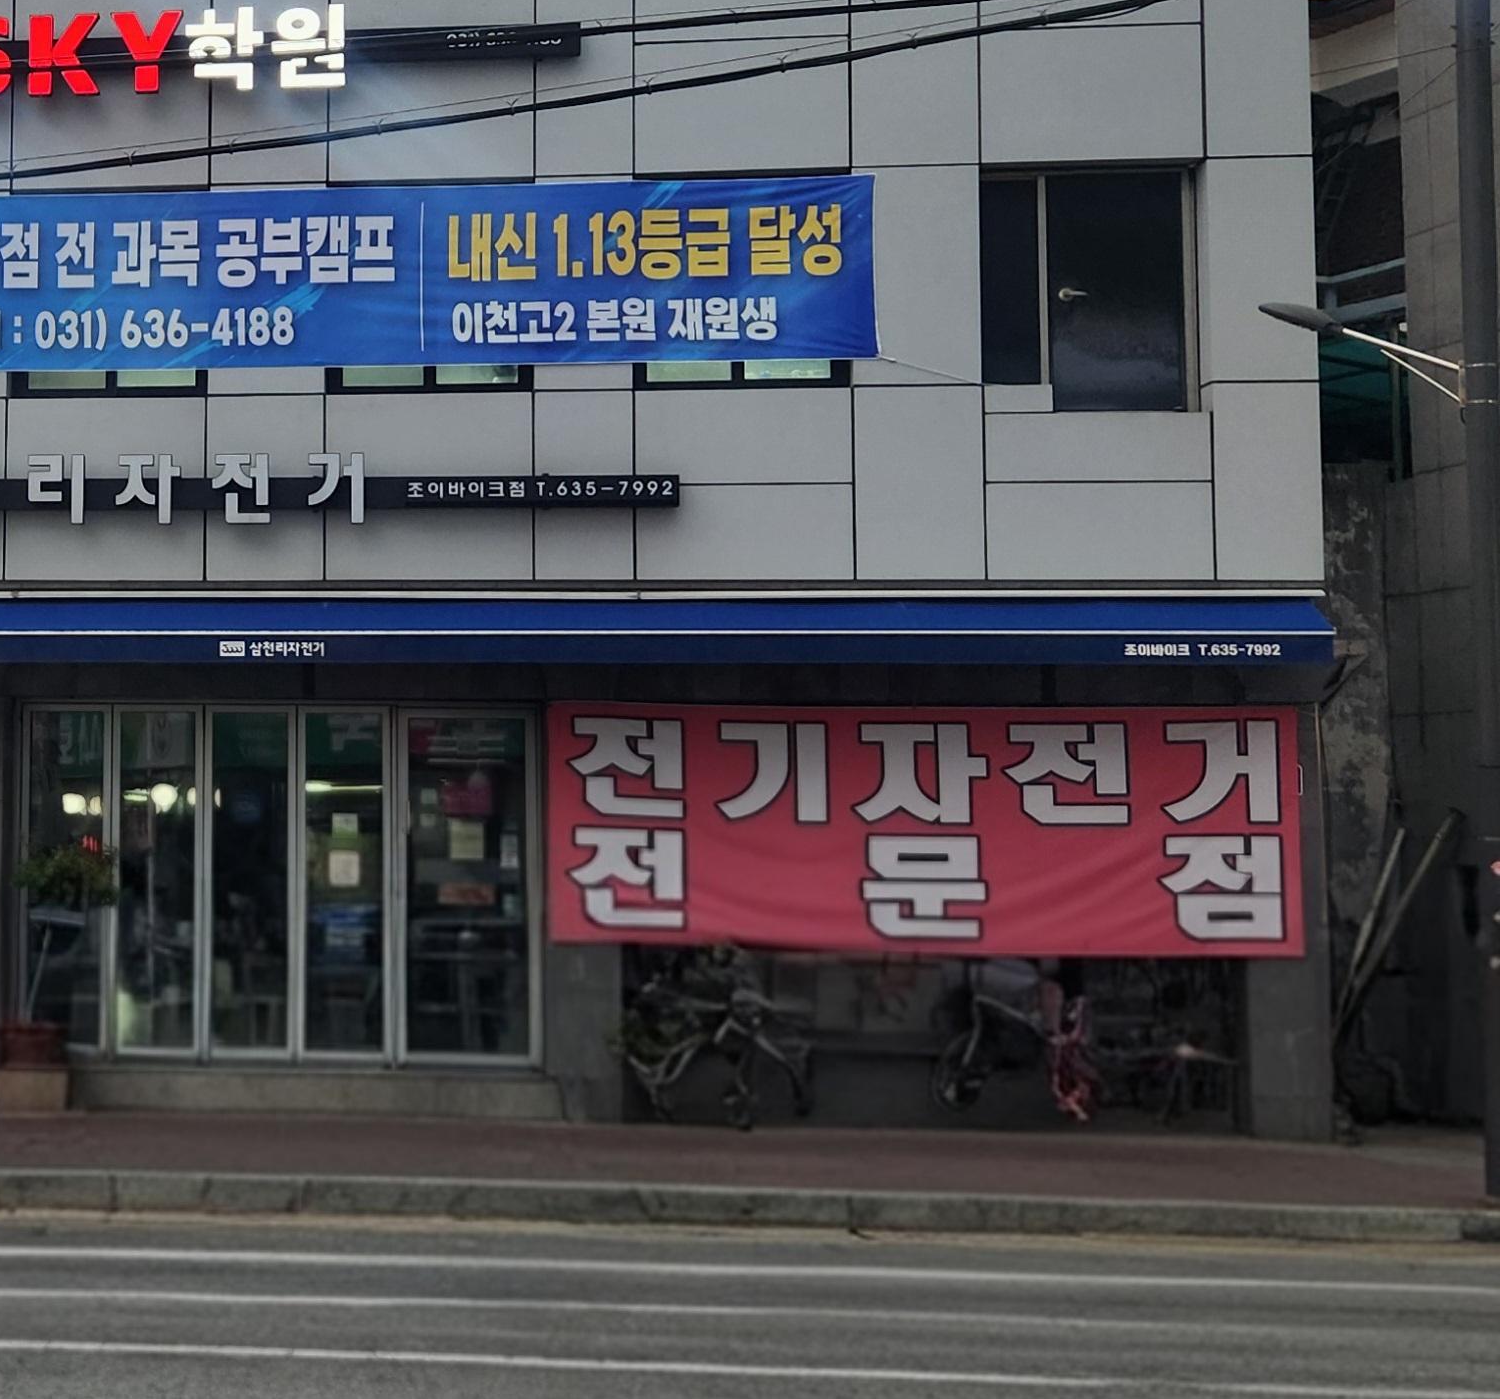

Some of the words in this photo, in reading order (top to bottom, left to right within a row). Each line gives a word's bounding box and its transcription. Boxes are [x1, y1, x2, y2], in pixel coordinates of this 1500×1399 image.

[54, 220, 96, 290] 전
[111, 218, 200, 289] 과목
[214, 214, 396, 288] 공부캠프
[447, 211, 537, 283] 내신
[553, 207, 731, 280] 1.13등급
[748, 203, 843, 277] 달성
[34, 308, 107, 353] 031)
[119, 306, 296, 350] 636-4188
[451, 299, 577, 345] 이천고2
[586, 298, 658, 342] 본원
[667, 296, 779, 342] 재원생
[406, 480, 526, 499] 조이바이크점
[536, 480, 674, 498] T.635-7992
[249, 641, 325, 657] 삼천리자전거
[1124, 643, 1191, 657] 조이바이크
[1197, 643, 1282, 657] T.635-7992
